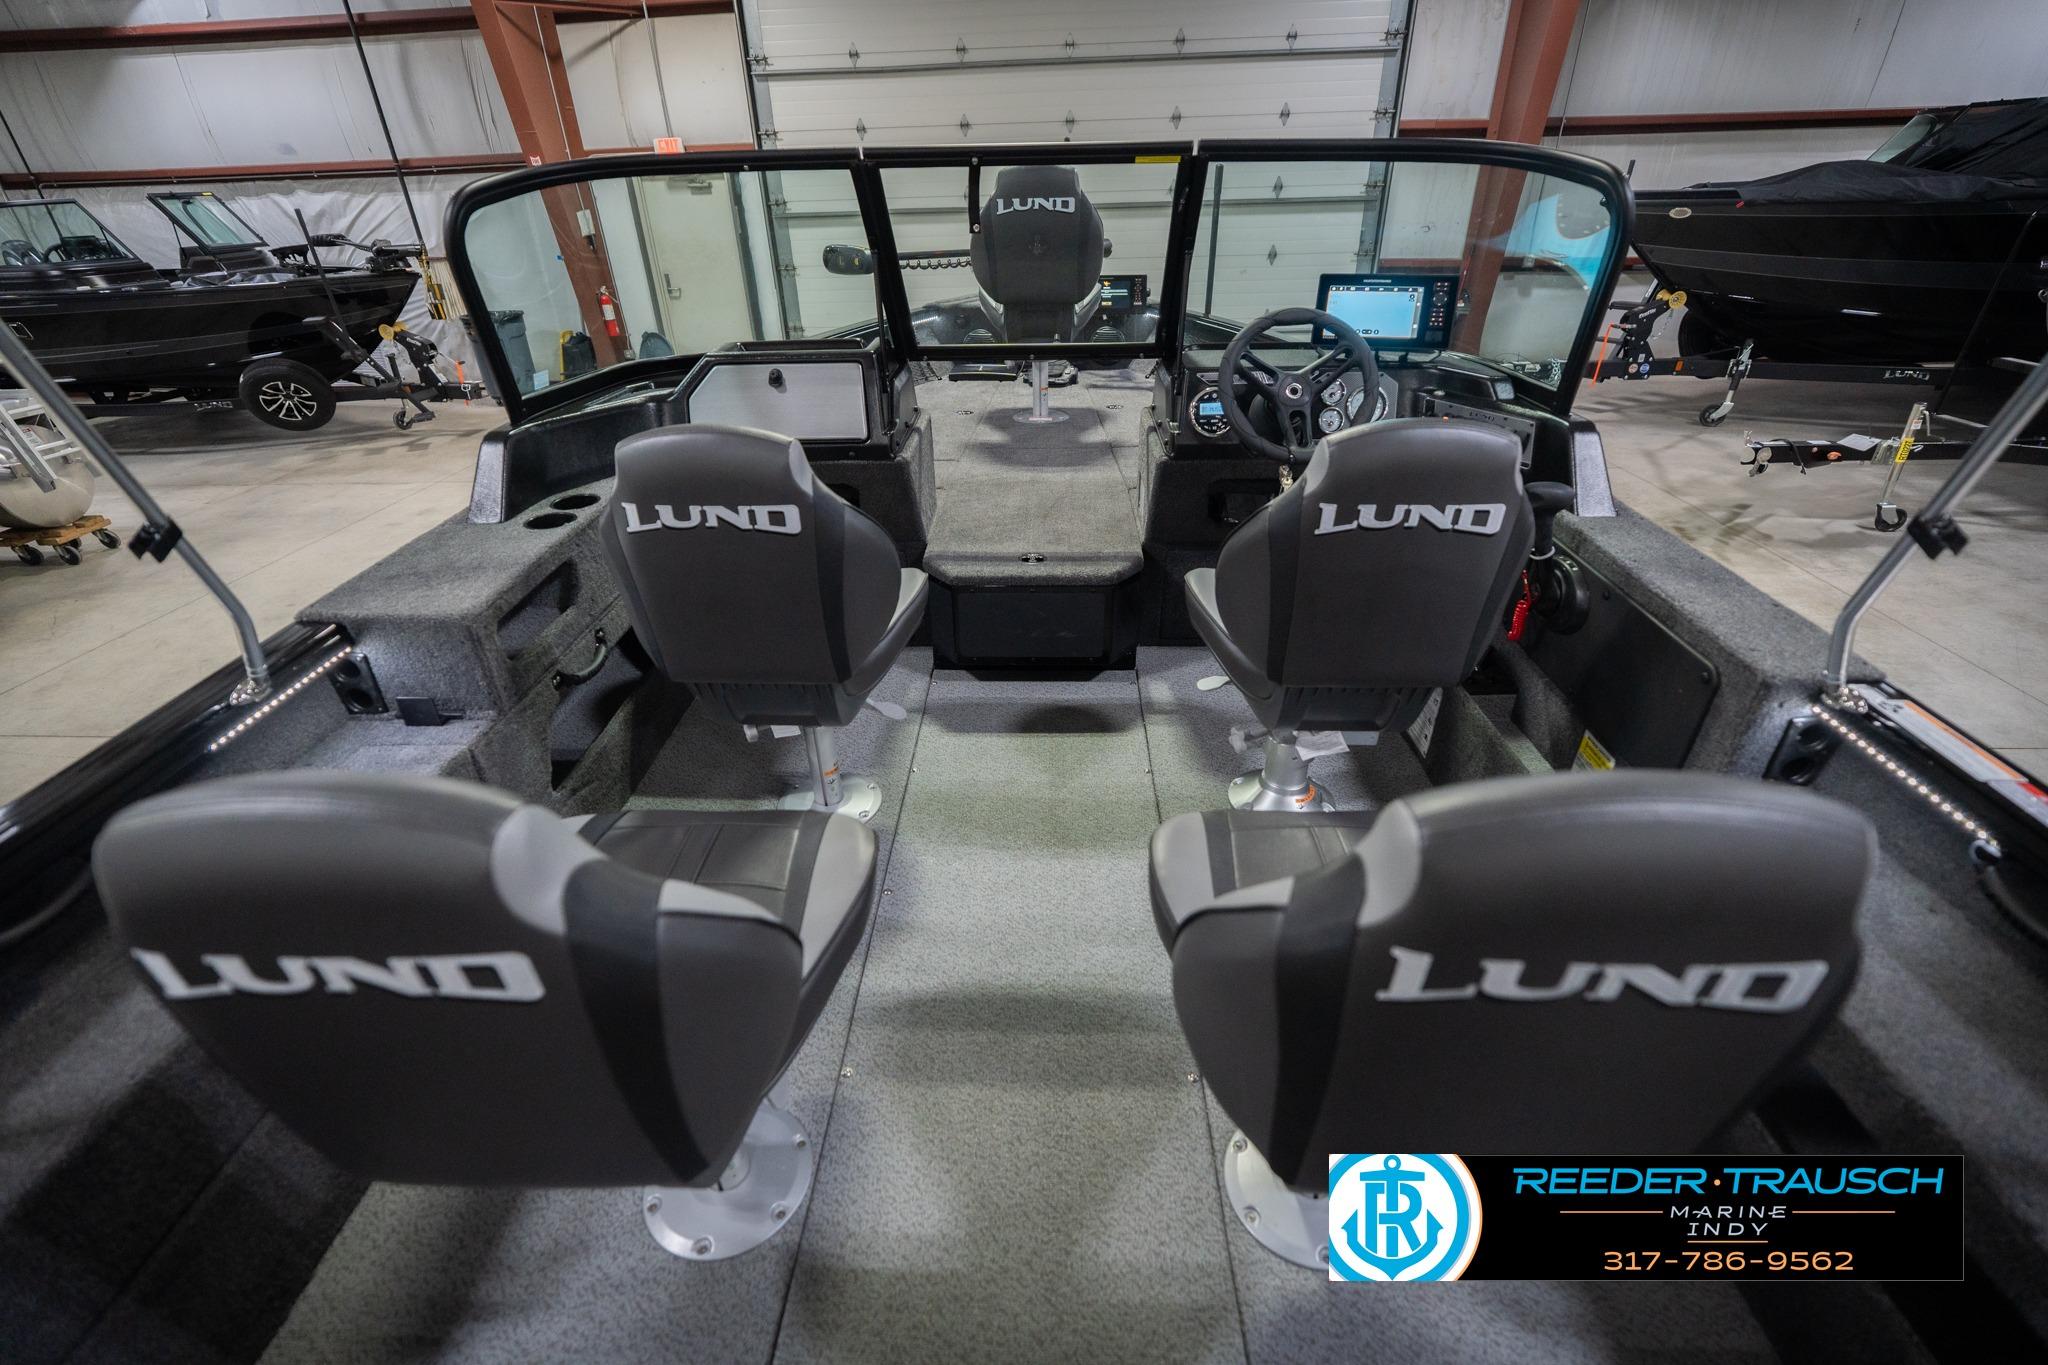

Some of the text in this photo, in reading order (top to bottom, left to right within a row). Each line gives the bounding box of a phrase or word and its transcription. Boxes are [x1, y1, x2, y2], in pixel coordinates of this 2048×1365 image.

[996, 197, 1076, 215] LUND
[621, 502, 801, 534] LUND
[1314, 502, 1507, 535] LUND
[132, 947, 546, 1003] LUND
[1376, 946, 1828, 1011] LUND
